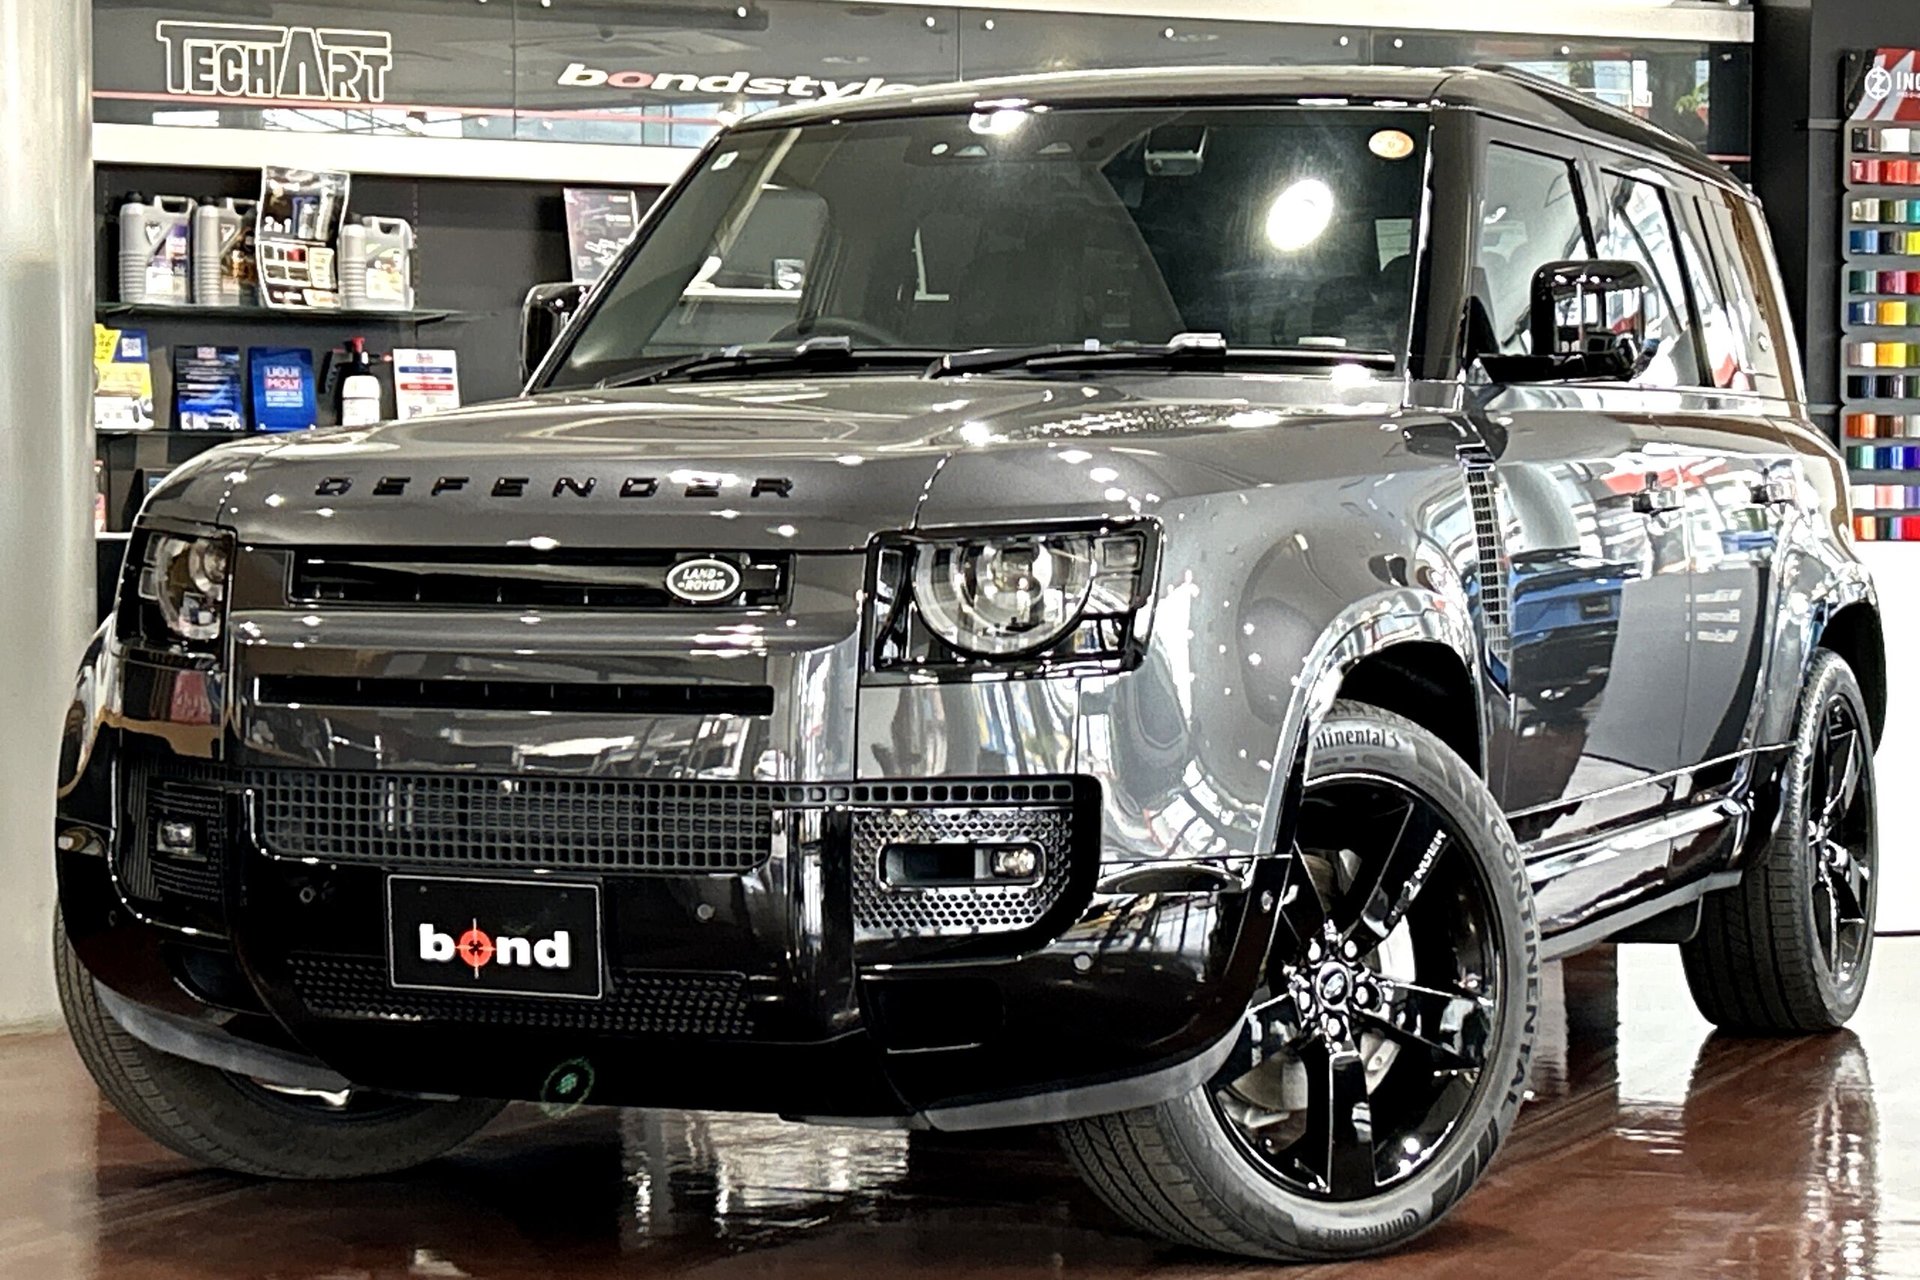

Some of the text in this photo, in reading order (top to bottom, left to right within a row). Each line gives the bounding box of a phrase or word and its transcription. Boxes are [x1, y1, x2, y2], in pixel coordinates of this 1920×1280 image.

[156, 20, 393, 102] TECHART
[314, 475, 796, 499] DEFENDER
[418, 921, 571, 969] bond
